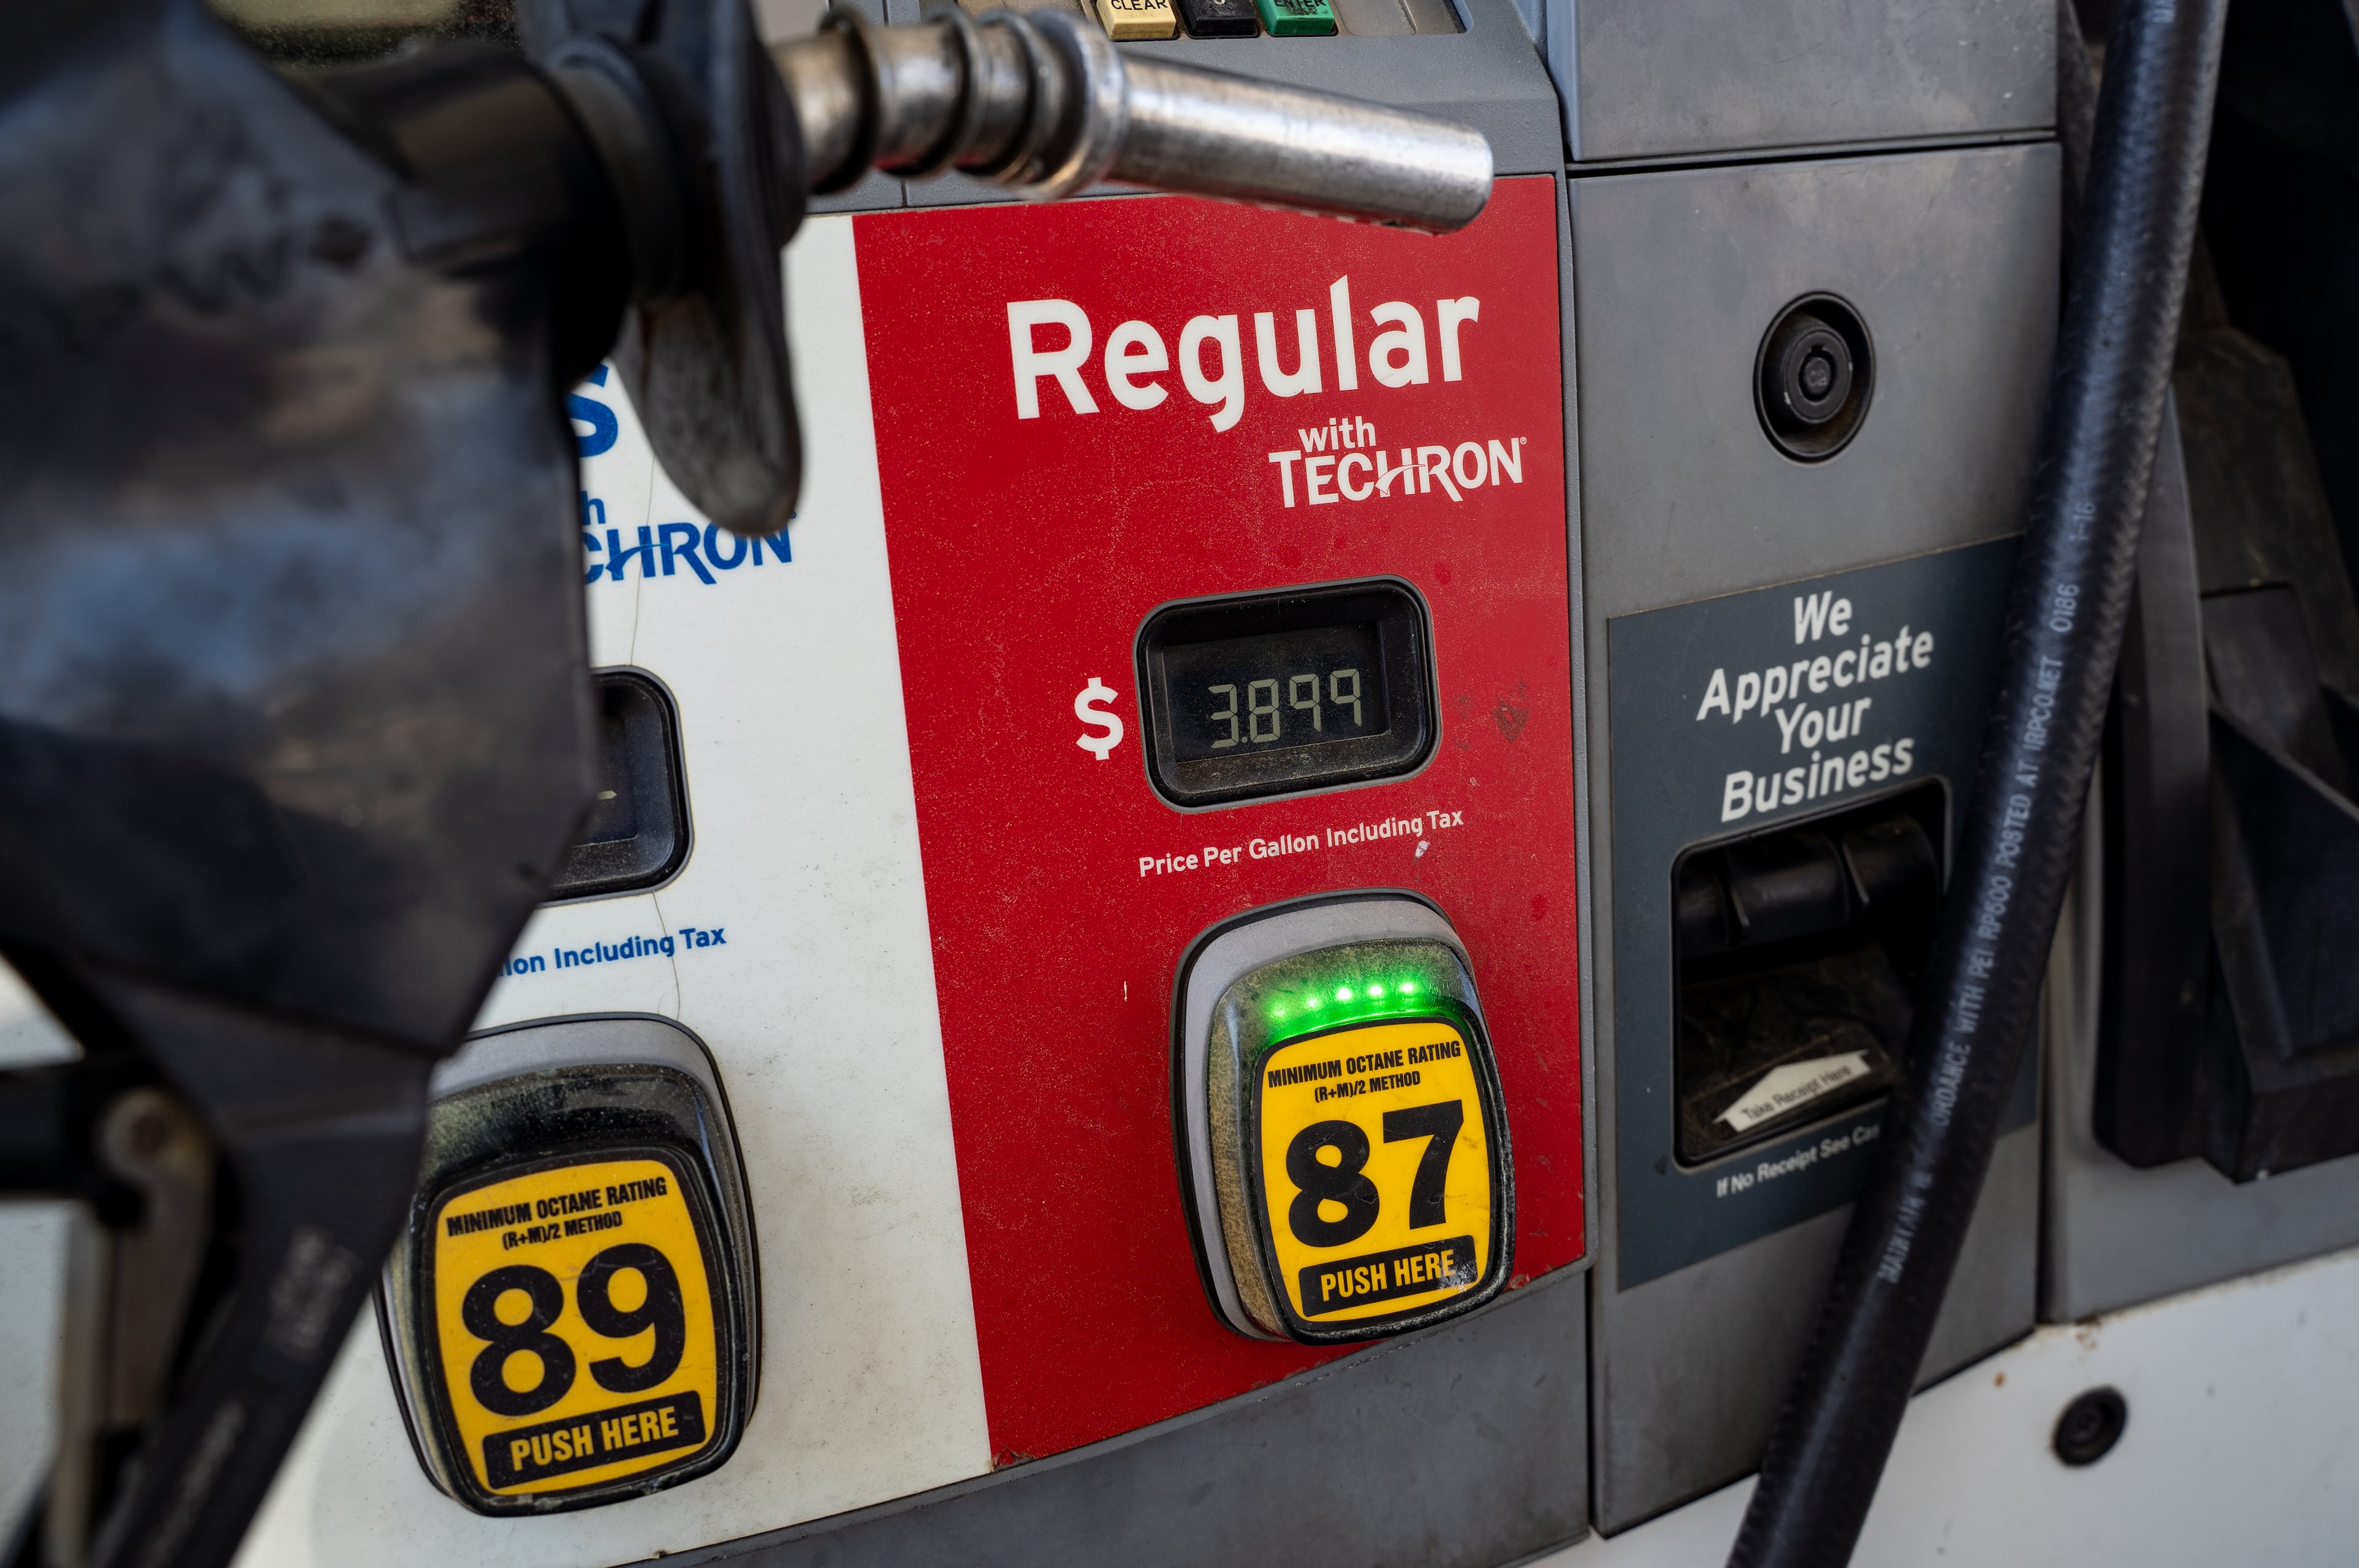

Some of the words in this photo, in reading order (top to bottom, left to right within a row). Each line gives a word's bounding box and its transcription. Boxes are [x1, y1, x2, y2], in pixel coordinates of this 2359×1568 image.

[1111, 0, 1168, 10] CLEAR
[1006, 275, 1481, 433] Regular
[1297, 415, 1377, 453] with
[1794, 590, 1852, 644] We
[1696, 624, 1935, 725] Appreciate
[1073, 676, 1124, 761] $
[1208, 668, 1363, 749] 3.899
[1774, 696, 1872, 754] Your
[1720, 737, 1915, 823] Business
[1139, 853, 1198, 877] Price
[1203, 845, 1242, 867] Per
[1248, 833, 1319, 859] Gallon
[1326, 815, 1423, 848] Including
[1426, 810, 1464, 830] Tax
[1950, 983, 1986, 1036] WITH
[1993, 792, 2033, 870] POSTED
[2013, 757, 2041, 790] AT
[554, 935, 676, 969] Including
[679, 927, 726, 950] Tax
[1267, 1059, 1342, 1088] MINIMUM
[1346, 1050, 1404, 1075] OCTANE
[1407, 1040, 1461, 1064] RATING
[1314, 1082, 1367, 1104] (R+M)/2
[1369, 1071, 1421, 1093] METHOD
[1740, 1101, 1775, 1120] Take
[1772, 1077, 1823, 1107] Receipt
[1818, 1065, 1852, 1086] Here
[1286, 1099, 1465, 1248] 87
[1716, 1177, 1732, 1198] If
[1731, 1172, 1755, 1195] No
[1757, 1145, 1817, 1184] Receipt
[1820, 1134, 1851, 1159] See
[446, 1202, 532, 1237] MINIMUM
[536, 1188, 603, 1218] OCTANE
[606, 1176, 668, 1204] RATING
[502, 1223, 562, 1250] (R+M)/2
[565, 1211, 623, 1236] METHOD
[1320, 1263, 1388, 1302] PUSH
[1393, 1249, 1456, 1287] HERE
[461, 1242, 686, 1417] 89
[509, 1424, 595, 1472] PUSH
[601, 1406, 679, 1451] HERE
